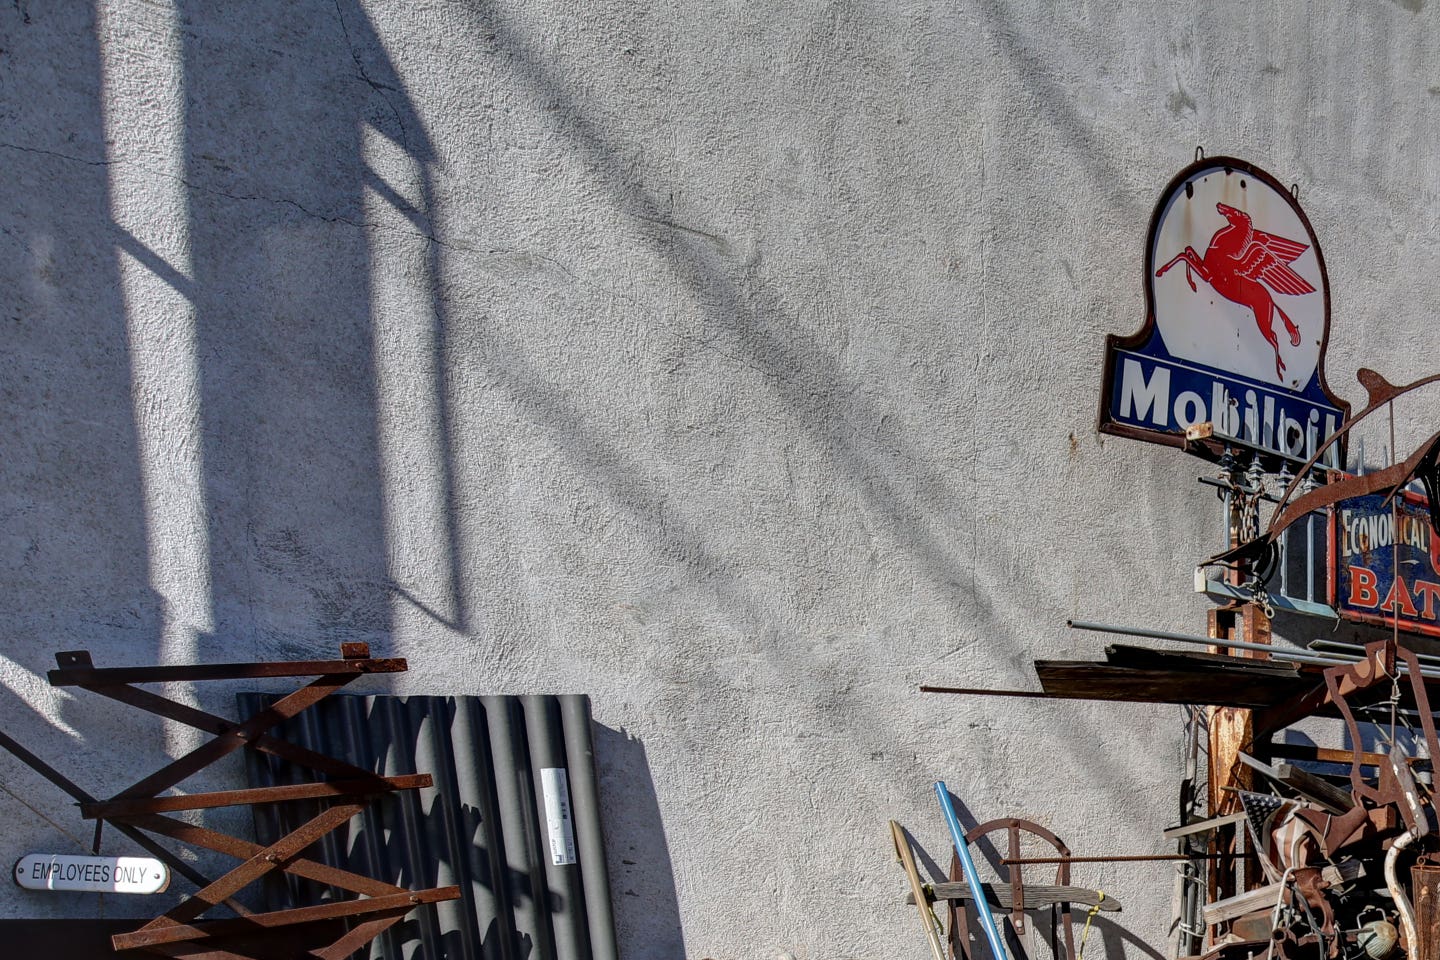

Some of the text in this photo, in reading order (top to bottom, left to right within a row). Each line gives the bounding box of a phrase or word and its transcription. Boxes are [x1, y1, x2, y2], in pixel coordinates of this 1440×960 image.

[1119, 358, 1336, 468] Mobiloil
[32, 862, 147, 884] EMPLOYEES ONLY
